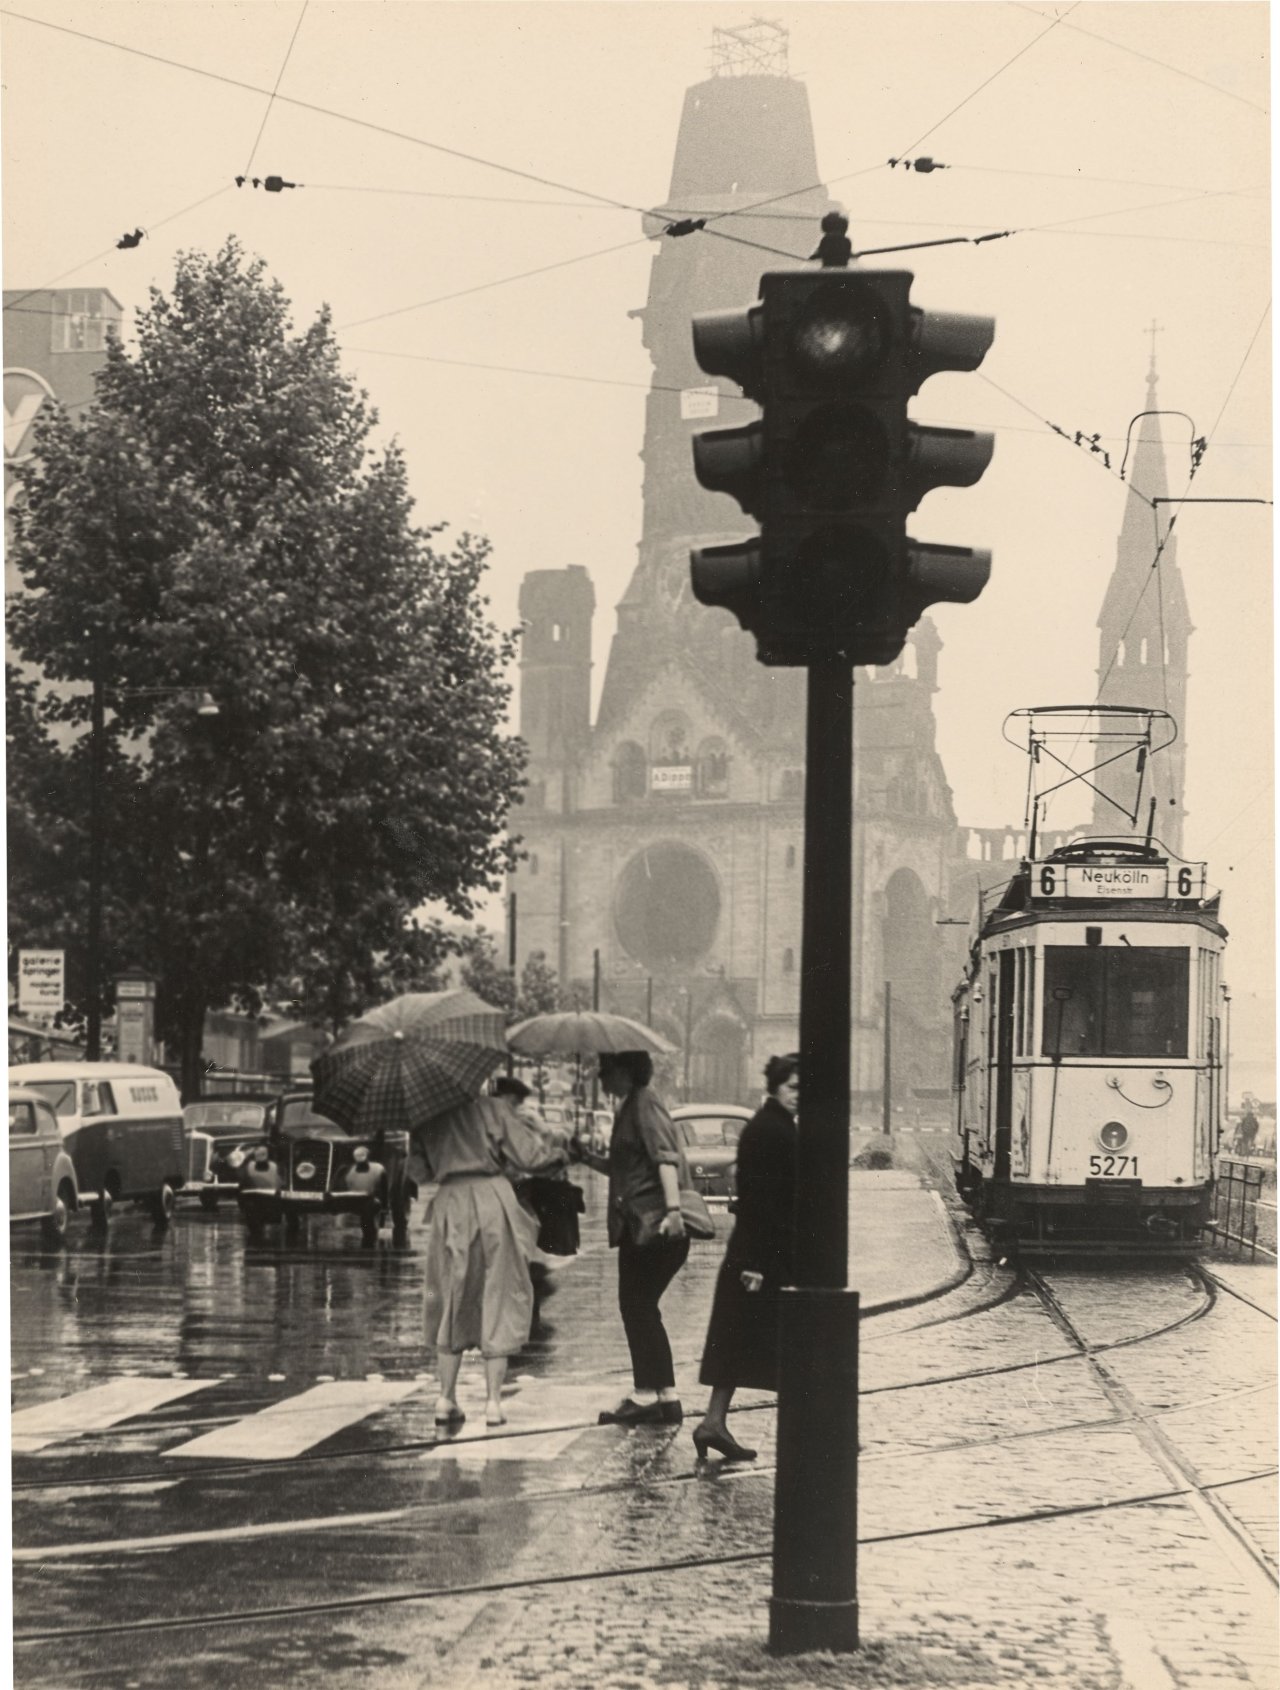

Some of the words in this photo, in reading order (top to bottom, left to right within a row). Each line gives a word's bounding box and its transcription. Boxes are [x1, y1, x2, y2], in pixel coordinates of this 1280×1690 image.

[1040, 866, 1056, 896] 6
[1082, 869, 1149, 884] Neukölln
[1177, 867, 1193, 897] 6
[1089, 1155, 1138, 1176] 5271
